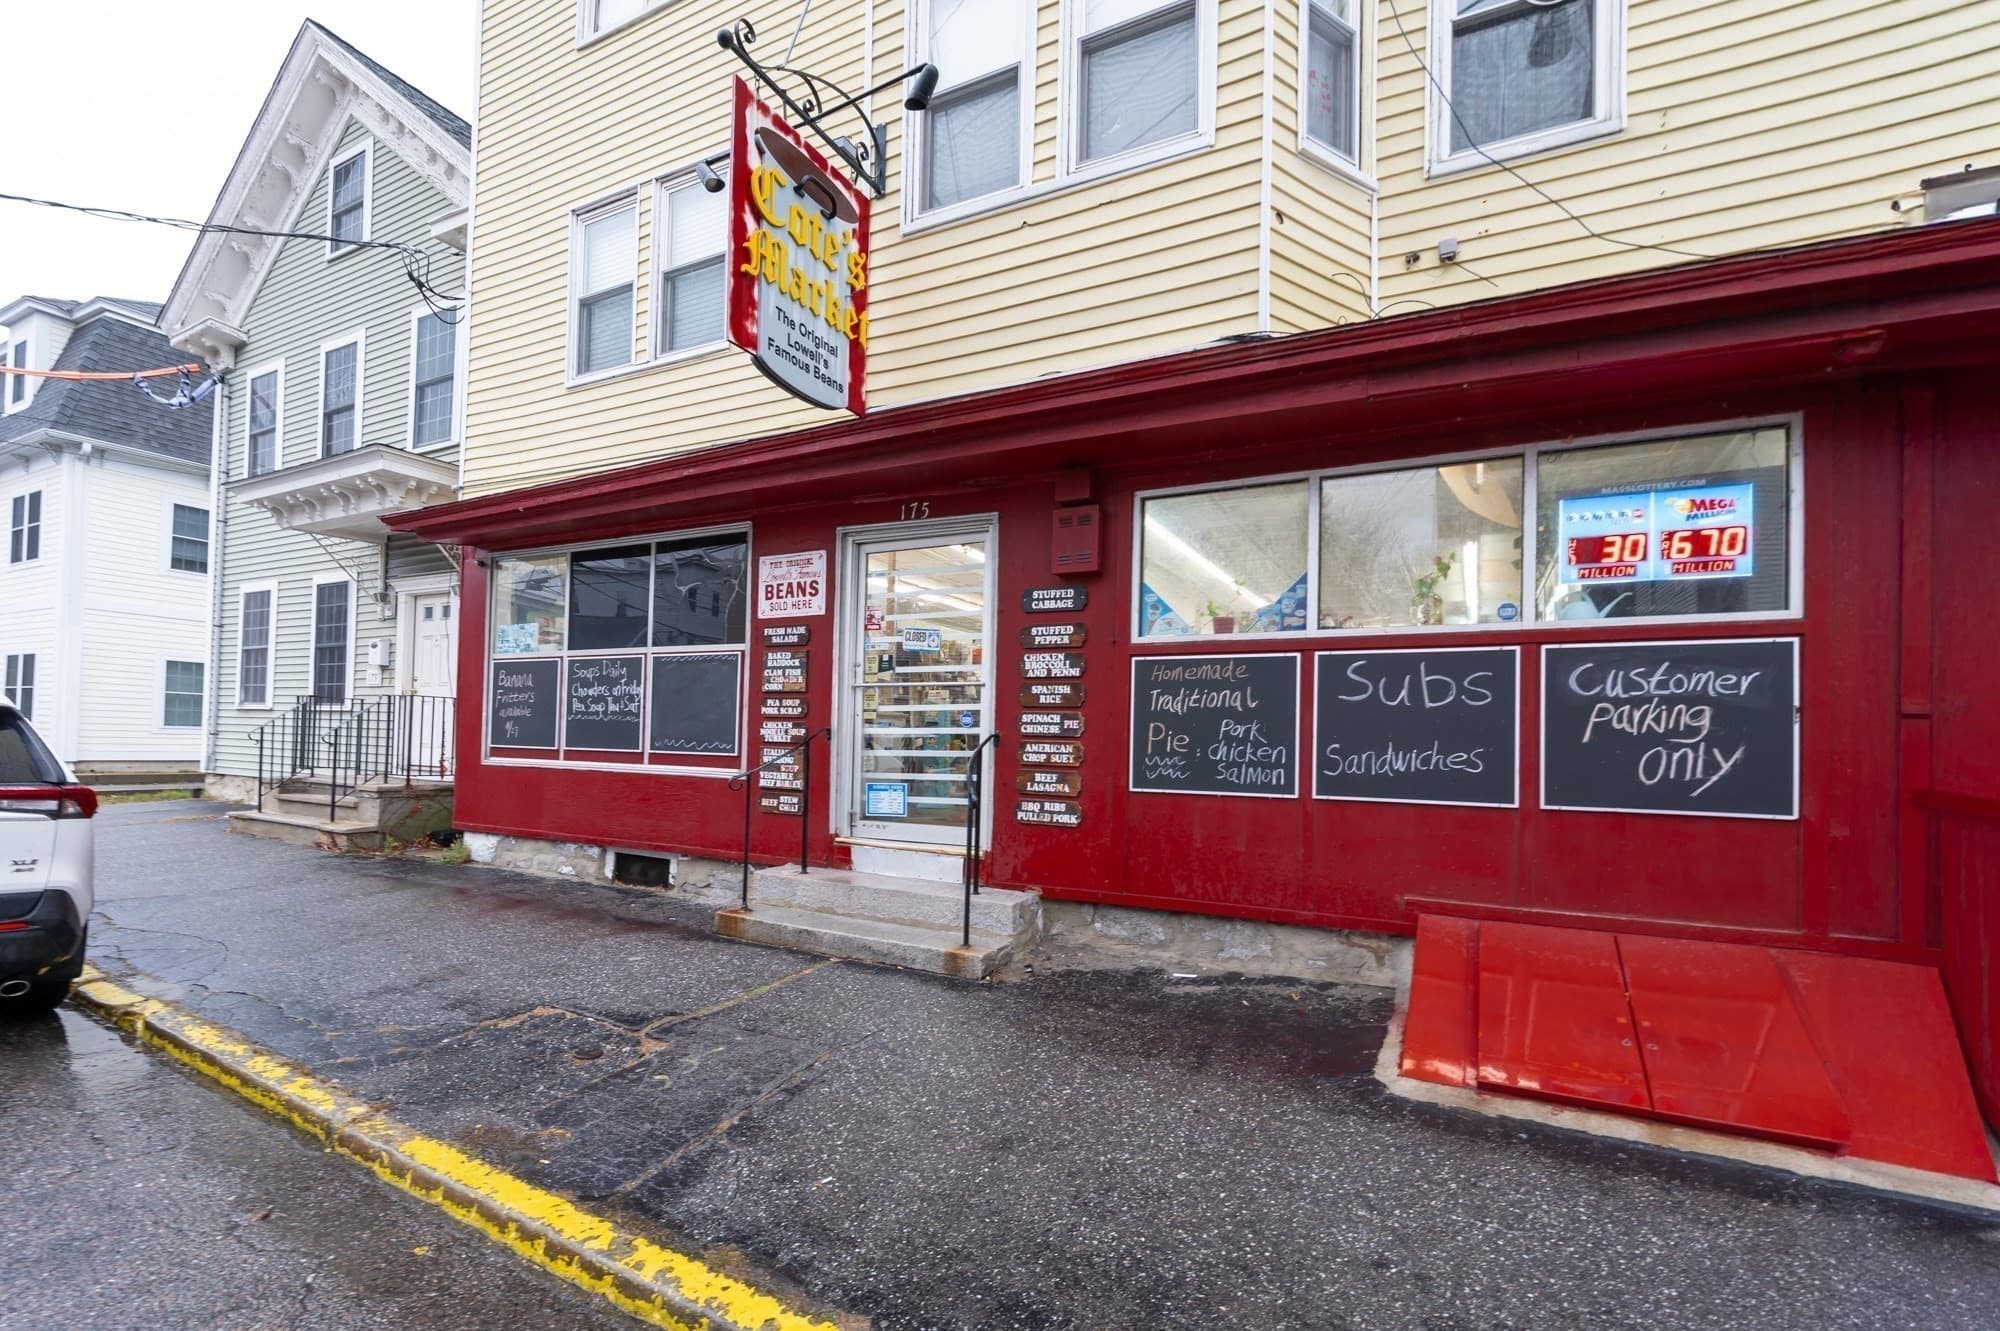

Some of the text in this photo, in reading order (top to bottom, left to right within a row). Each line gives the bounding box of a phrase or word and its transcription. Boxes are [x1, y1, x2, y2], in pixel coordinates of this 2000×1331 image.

[750, 165, 866, 290] Cote's
[741, 229, 869, 348] Market
[776, 306, 839, 358] The Original
[787, 333, 829, 370] Lowell's
[767, 337, 845, 394] Famous Beans
[1600, 479, 1706, 494] MASSLOTTERY.COM
[901, 502, 930, 521] 175
[1600, 534, 1647, 563] 30
[1670, 527, 1746, 559] 670
[1578, 566, 1635, 578] MILLION
[1671, 560, 1734, 573] MILLION
[765, 579, 820, 600] BEANS
[1032, 589, 1074, 599] STUFFED
[770, 599, 813, 611] SOLD HERE
[1031, 599, 1074, 609] CABBAGE
[764, 626, 807, 636] FRESH MADE
[1031, 625, 1074, 636] STUFFED
[771, 635, 798, 643] SALADS
[904, 631, 927, 642] CLOSED
[1034, 635, 1070, 645] PEPPER
[767, 652, 791, 660] BAKED
[1023, 653, 1065, 662] CHICKEN
[767, 659, 800, 667] HADDOCK
[1024, 661, 1070, 670] BROCCOLI
[572, 660, 626, 682] Soups Daily
[785, 668, 801, 676] FISH
[1027, 668, 1080, 678] AND PENNI
[1151, 659, 1249, 682] Homemade
[498, 670, 534, 688] Banana
[1338, 660, 1493, 708] Subs
[1568, 662, 1762, 696] Customer
[572, 681, 610, 698] Chowders
[1031, 685, 1071, 694] SPANISH
[782, 699, 800, 707] SOUP
[1039, 694, 1062, 704] RICE
[1150, 686, 1259, 716] Traditional
[761, 706, 802, 714] PORK SCRAP
[1021, 714, 1061, 723] SPINACH
[1021, 724, 1061, 733] CHINESE
[1064, 720, 1080, 729] PIE
[1219, 718, 1268, 744] Pork
[1147, 722, 1190, 755] Pie
[1024, 744, 1073, 753] AMERICAN
[1022, 753, 1076, 763] CHOP SUEY
[1323, 743, 1485, 776] Sandwiches
[1034, 773, 1058, 782] BEEF
[1026, 782, 1070, 793] LASAGNA
[1021, 802, 1066, 812] BBQ RIBS
[1017, 812, 1077, 824] PULLED PORK
